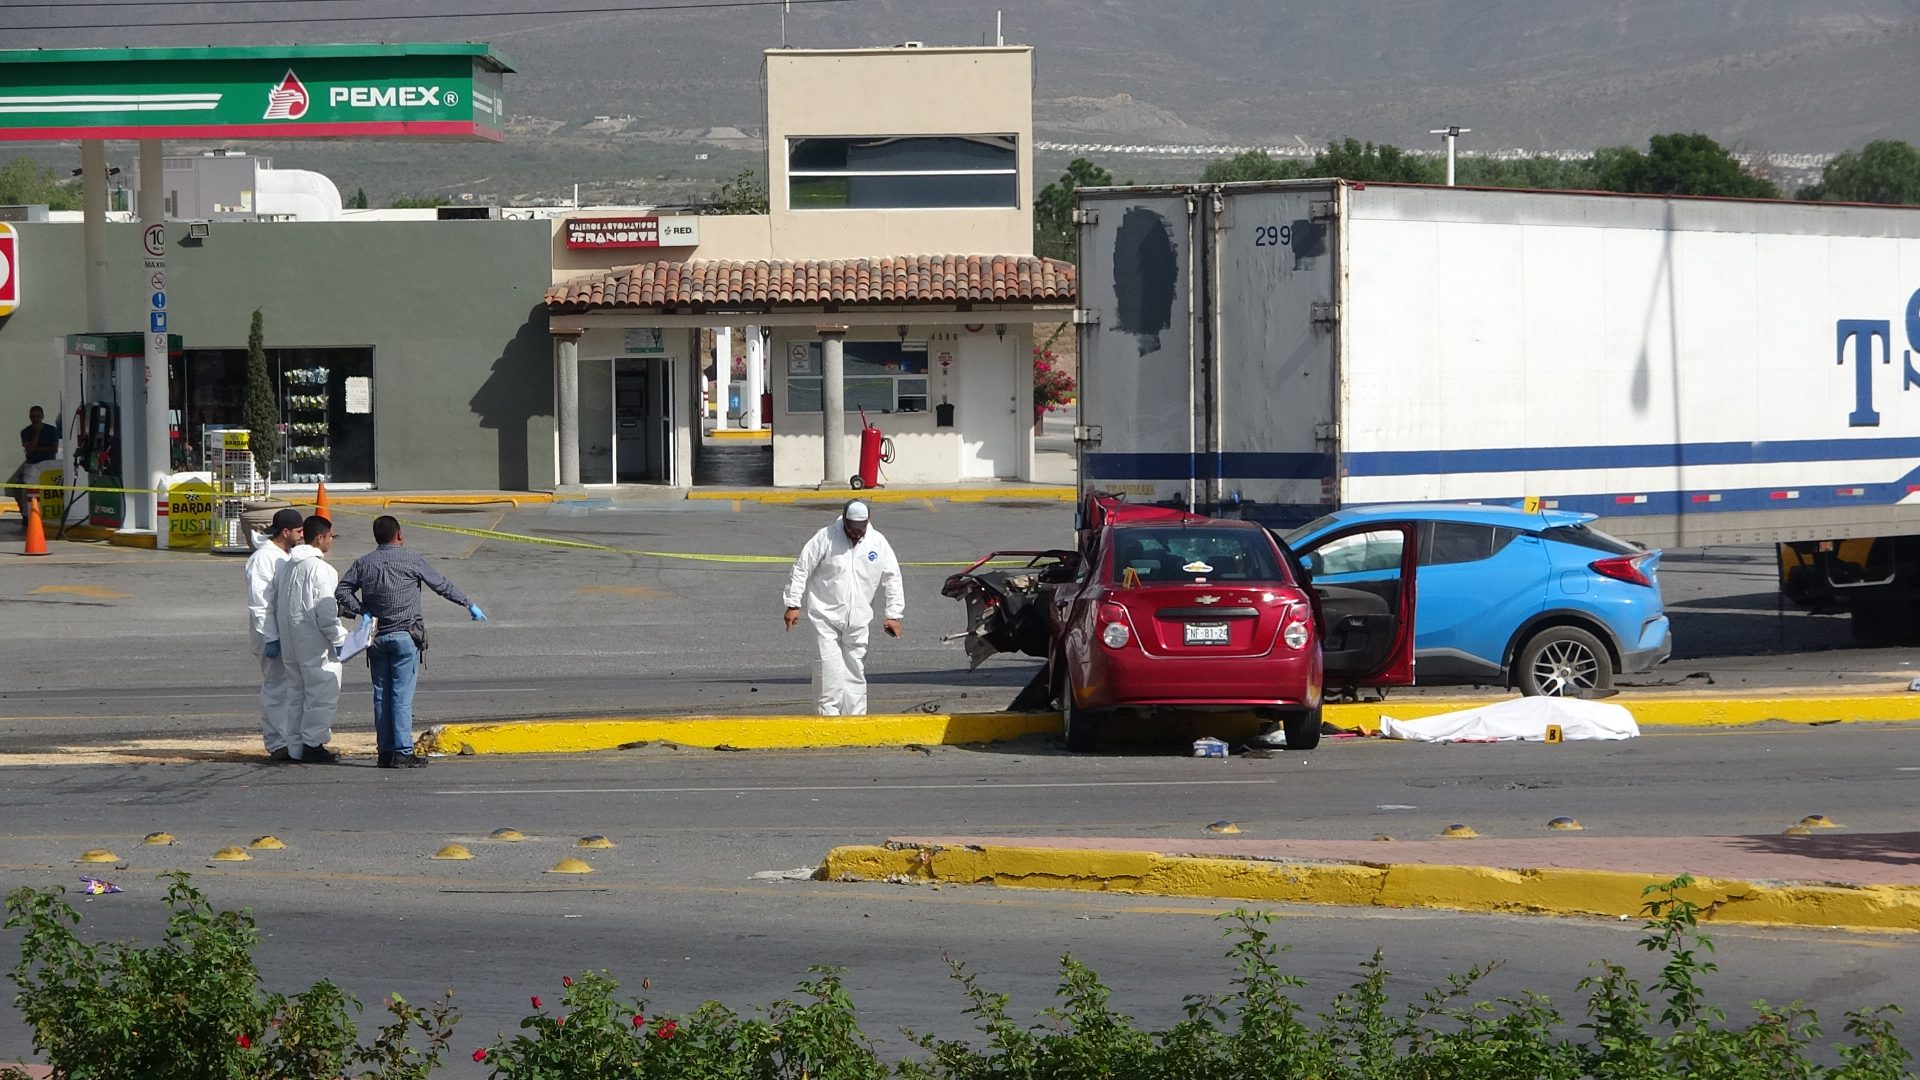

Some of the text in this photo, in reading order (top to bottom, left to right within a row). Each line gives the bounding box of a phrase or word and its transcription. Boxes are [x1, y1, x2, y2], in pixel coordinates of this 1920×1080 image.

[329, 86, 440, 107] PEMEX
[149, 229, 165, 245] 10
[585, 231, 657, 243] BANORTE
[673, 226, 692, 235] RED
[1255, 225, 1291, 247] 299
[172, 502, 212, 515] BARDA
